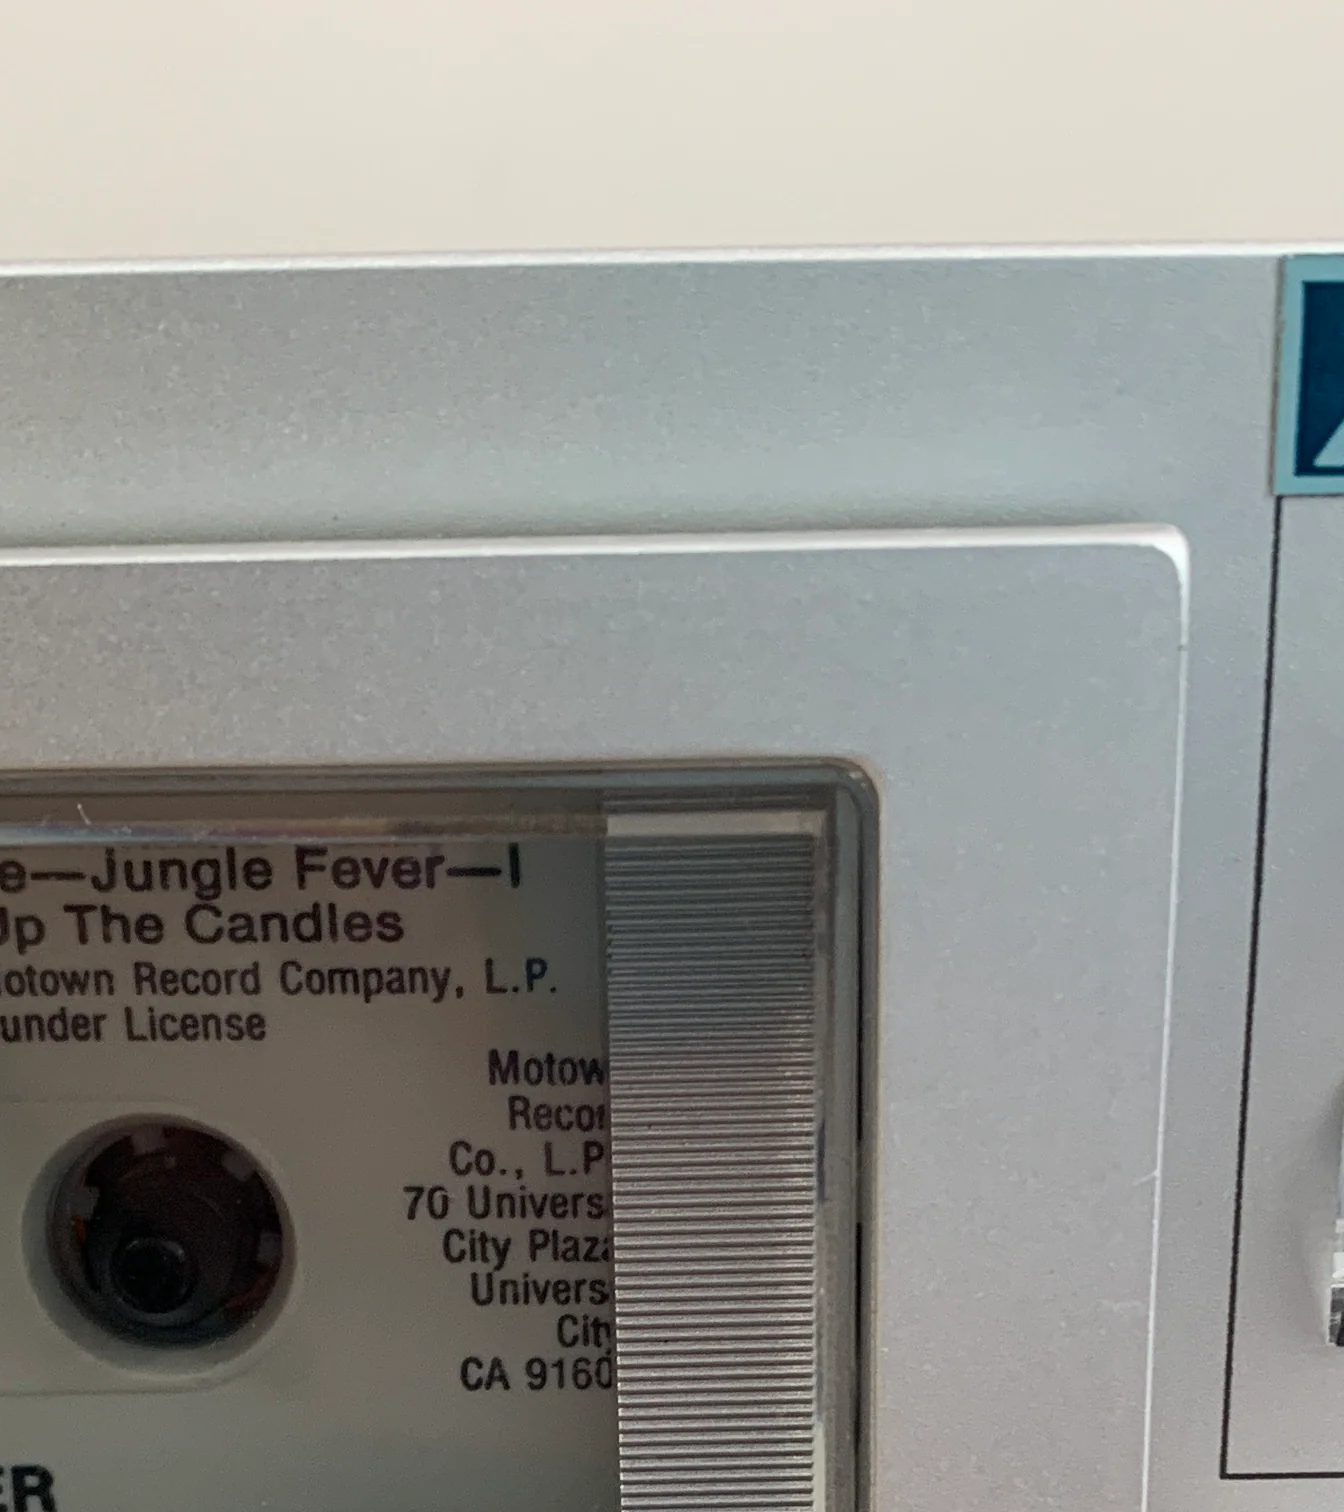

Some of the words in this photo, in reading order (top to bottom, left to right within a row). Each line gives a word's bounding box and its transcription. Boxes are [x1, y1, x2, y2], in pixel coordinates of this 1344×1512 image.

[62, 903, 166, 947] The
[184, 901, 406, 946] Candles
[133, 959, 263, 998] Record
[279, 959, 465, 1005] Company,
[484, 956, 560, 996] L.P.
[0, 1004, 109, 1046] under
[125, 1004, 268, 1045] License
[449, 1140, 523, 1179] Co.,
[404, 1185, 449, 1220] 70
[444, 1228, 512, 1272] City
[460, 1355, 511, 1392] CA
